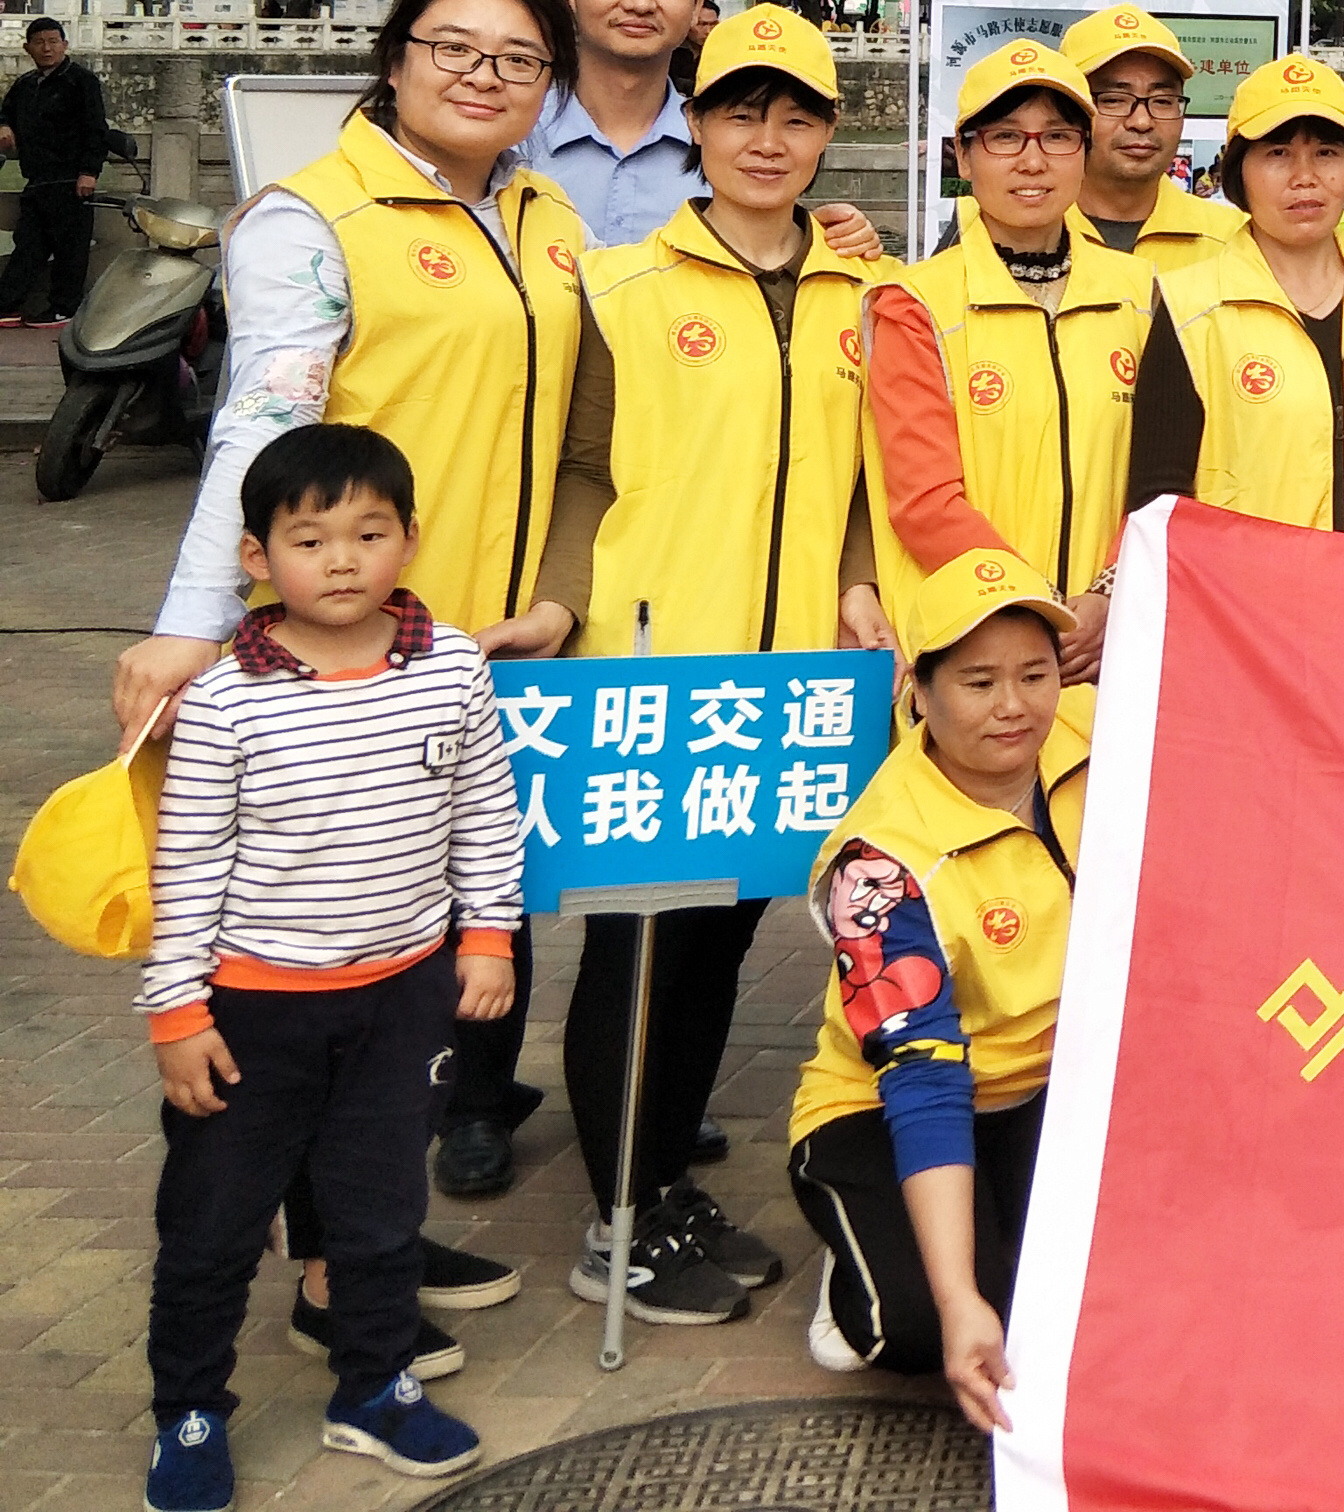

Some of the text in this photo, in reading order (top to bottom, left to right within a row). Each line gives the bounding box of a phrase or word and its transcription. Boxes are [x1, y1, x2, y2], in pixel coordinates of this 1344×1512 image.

[498, 677, 856, 759] 文明交通
[519, 761, 852, 849] 从我做起
